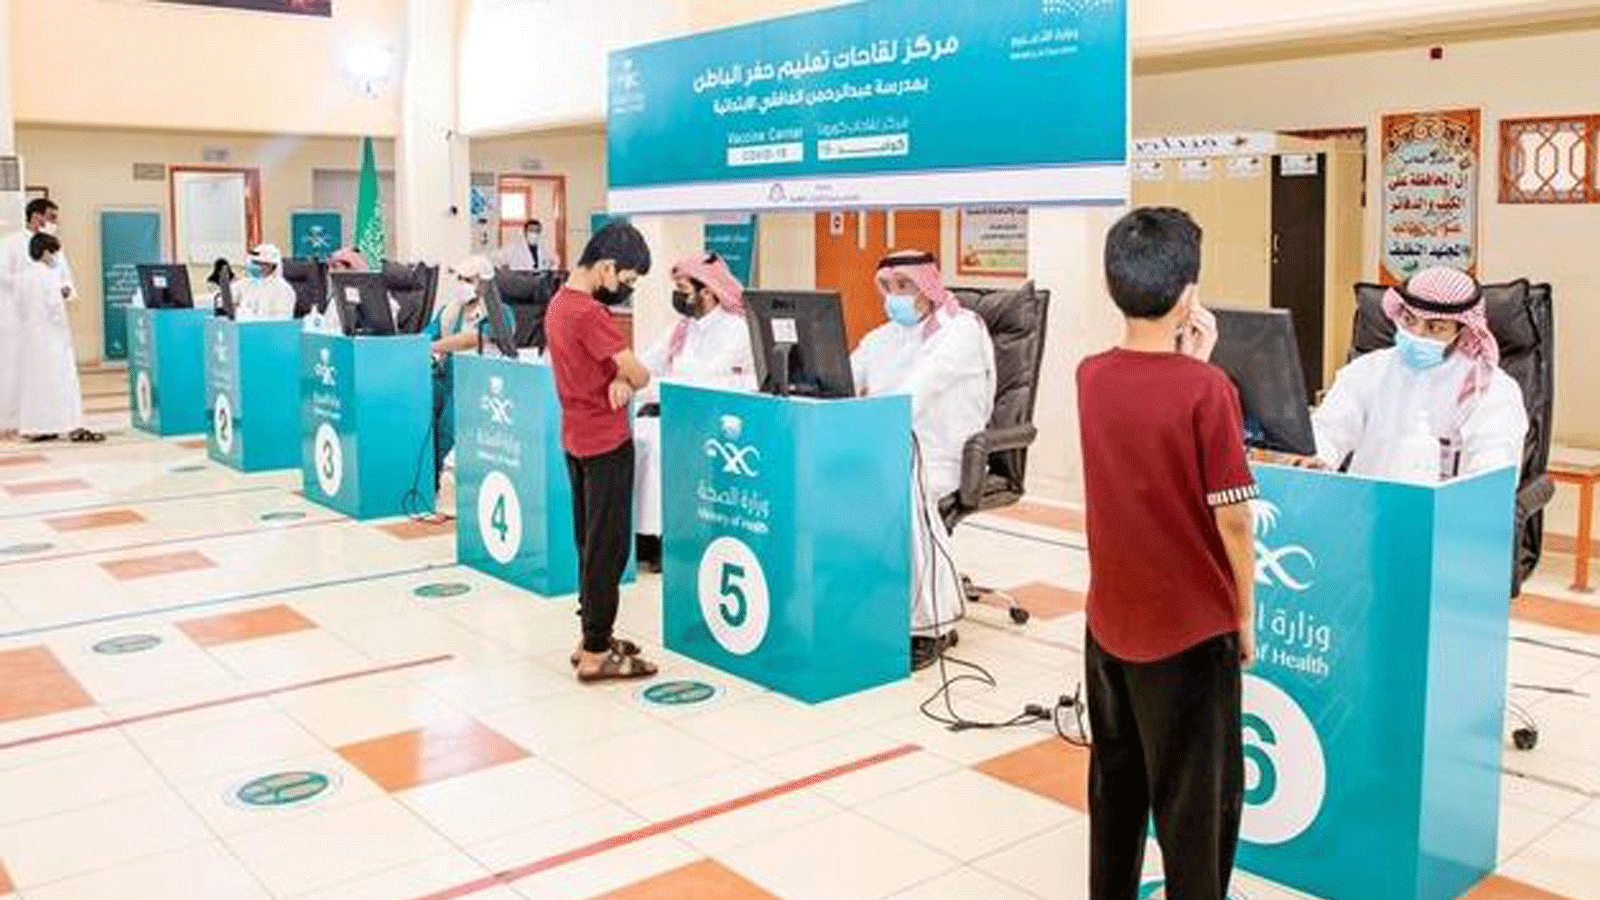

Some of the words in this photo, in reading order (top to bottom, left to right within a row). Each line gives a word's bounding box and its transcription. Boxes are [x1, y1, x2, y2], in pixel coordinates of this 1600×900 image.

[778, 50, 830, 81] تعليم
[833, 40, 898, 70] لقاحات
[901, 34, 959, 65] مركز
[693, 64, 743, 93] الباطن
[219, 407, 229, 443] 2
[322, 440, 335, 480] 3
[491, 493, 509, 542] 4
[719, 562, 747, 627] 5
[1271, 608, 1331, 652] وزارة
[1271, 647, 1329, 676] Health
[1241, 712, 1278, 806] 6
